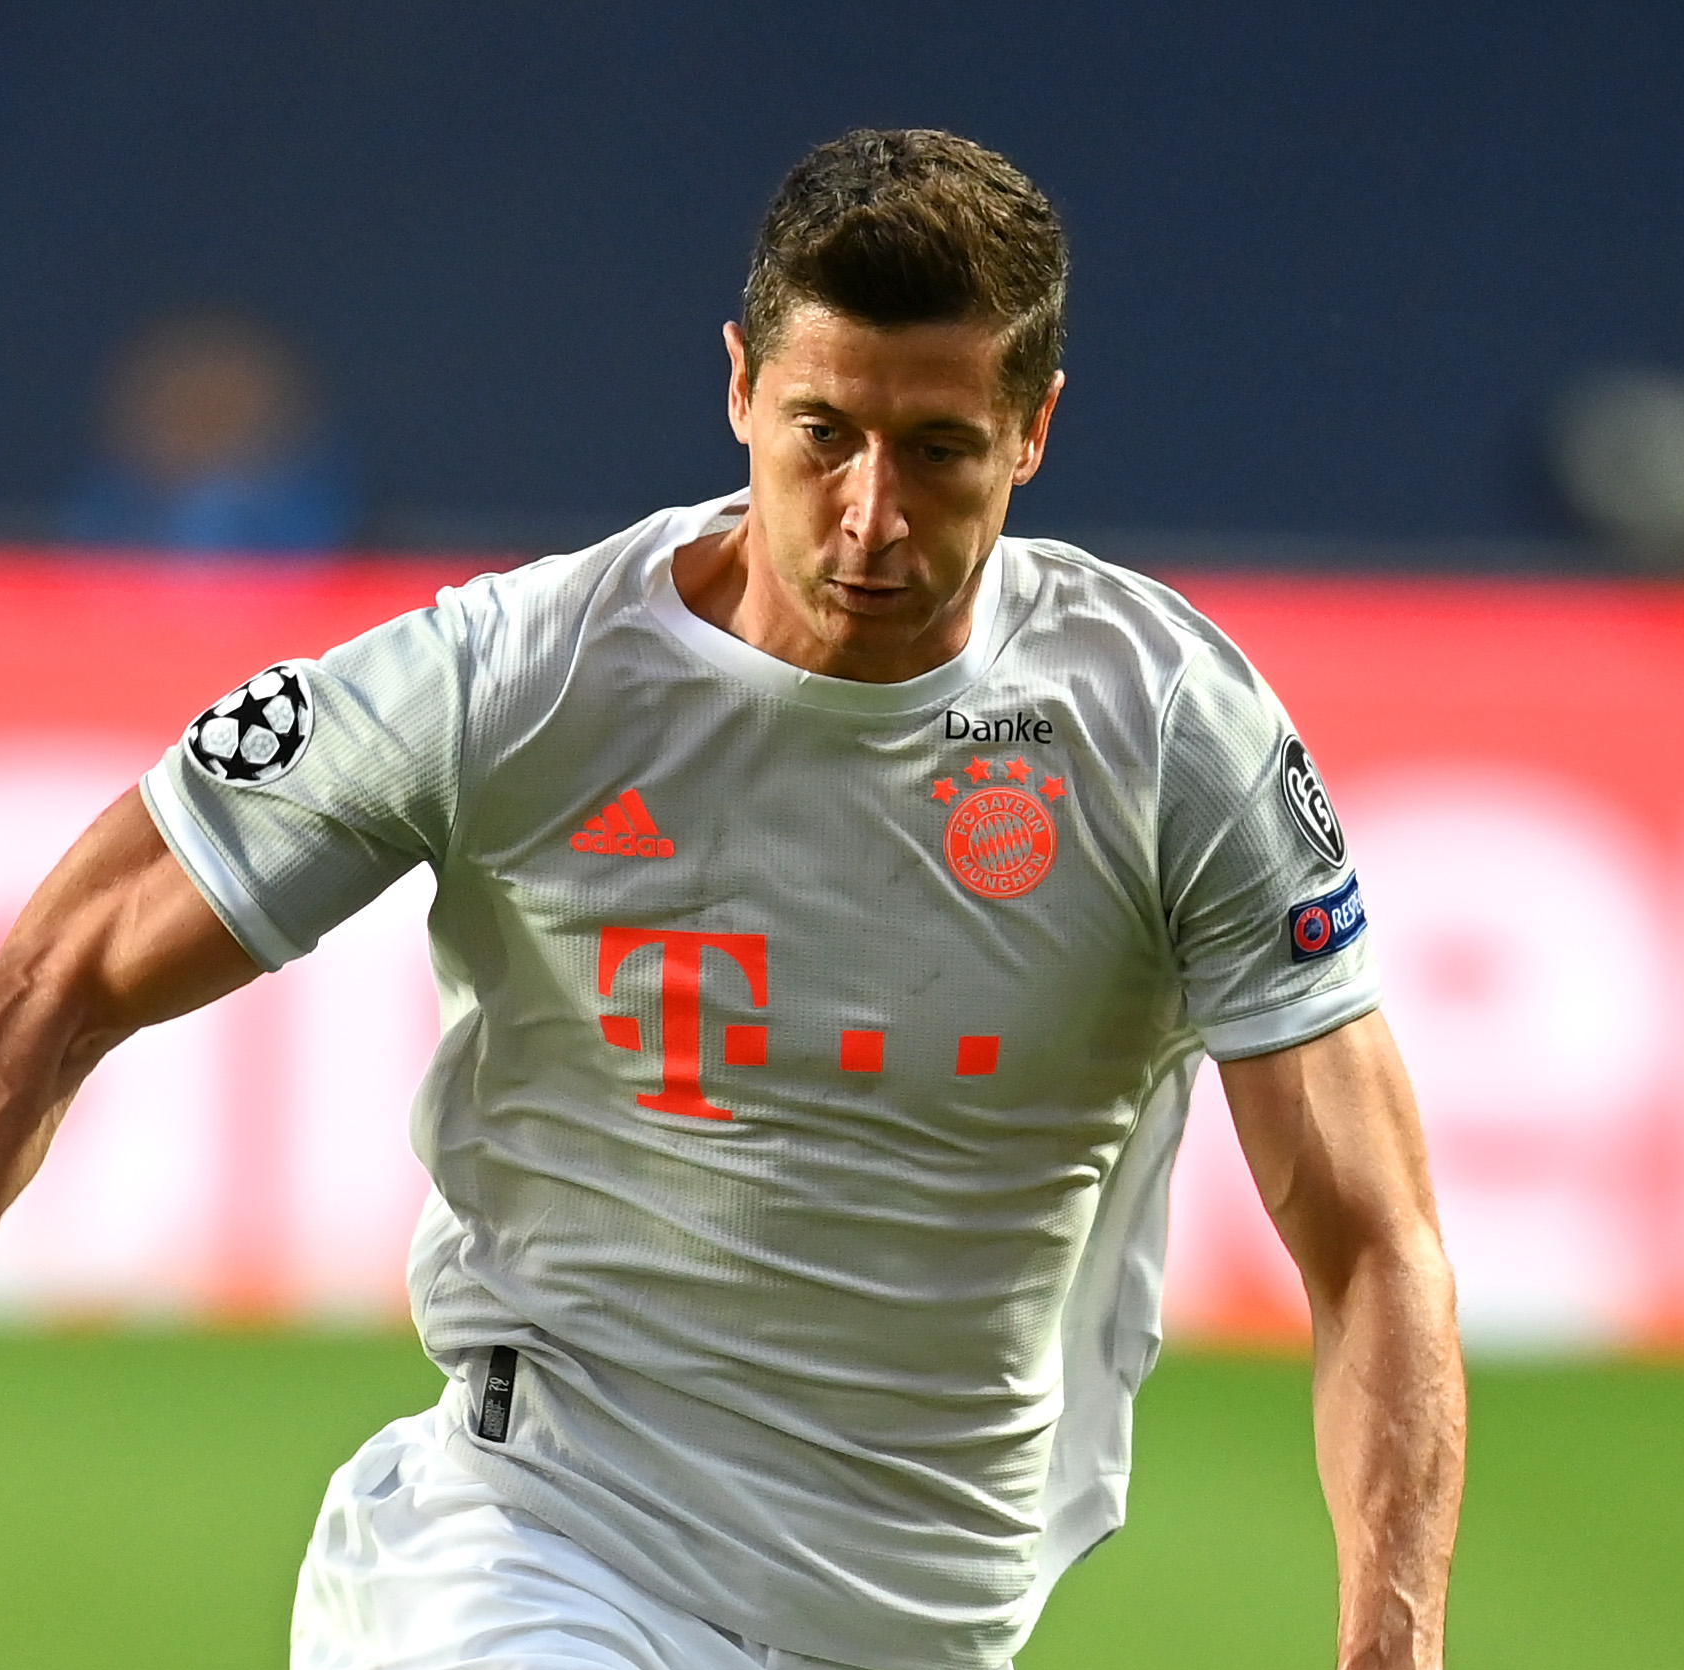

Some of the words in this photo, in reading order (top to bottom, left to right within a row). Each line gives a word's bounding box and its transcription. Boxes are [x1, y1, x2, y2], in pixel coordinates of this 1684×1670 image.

[945, 710, 1054, 744] Danke
[954, 812, 976, 837] FC
[976, 796, 1046, 833] BAYERN
[1314, 796, 1331, 832] 5
[570, 831, 675, 858] adidas
[598, 926, 768, 1121] T
